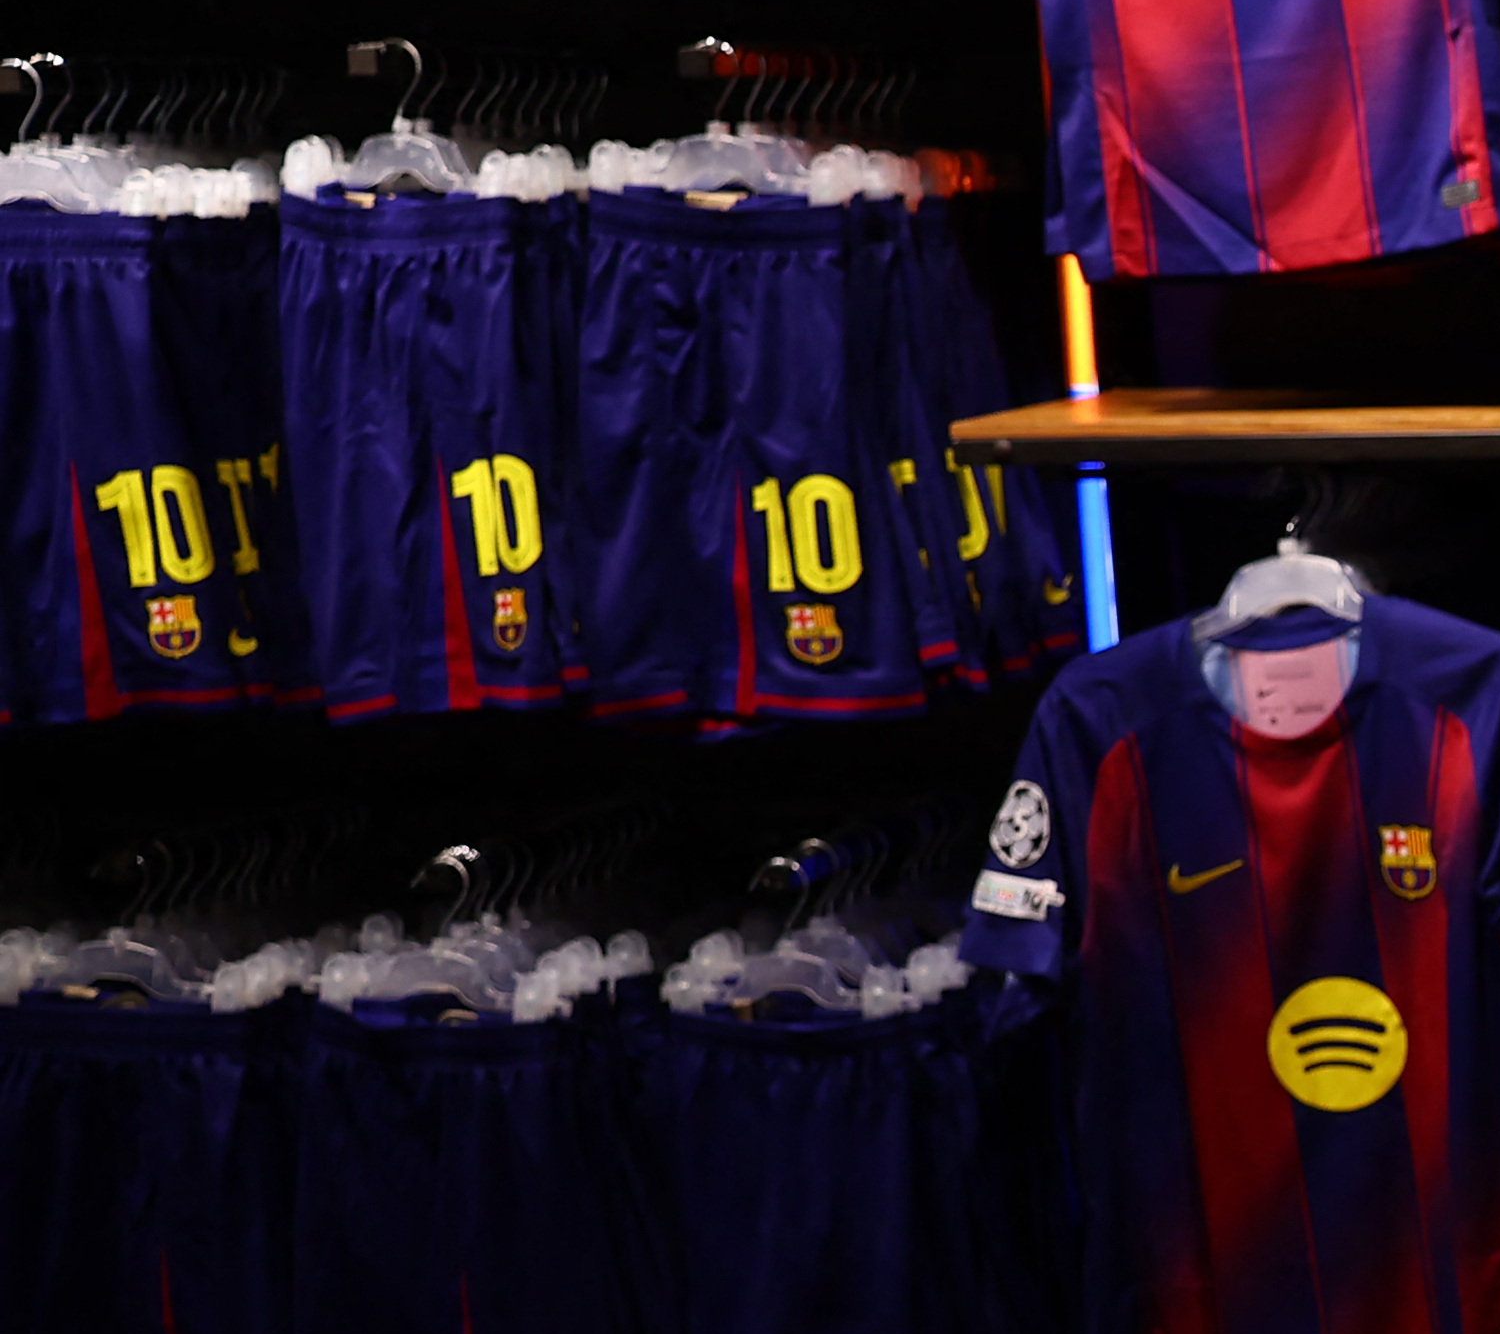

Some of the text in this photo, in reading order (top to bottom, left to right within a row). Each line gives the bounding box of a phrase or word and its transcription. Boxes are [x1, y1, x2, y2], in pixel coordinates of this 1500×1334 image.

[95, 464, 214, 587] 10
[451, 454, 543, 576] 10
[752, 474, 863, 593] 10
